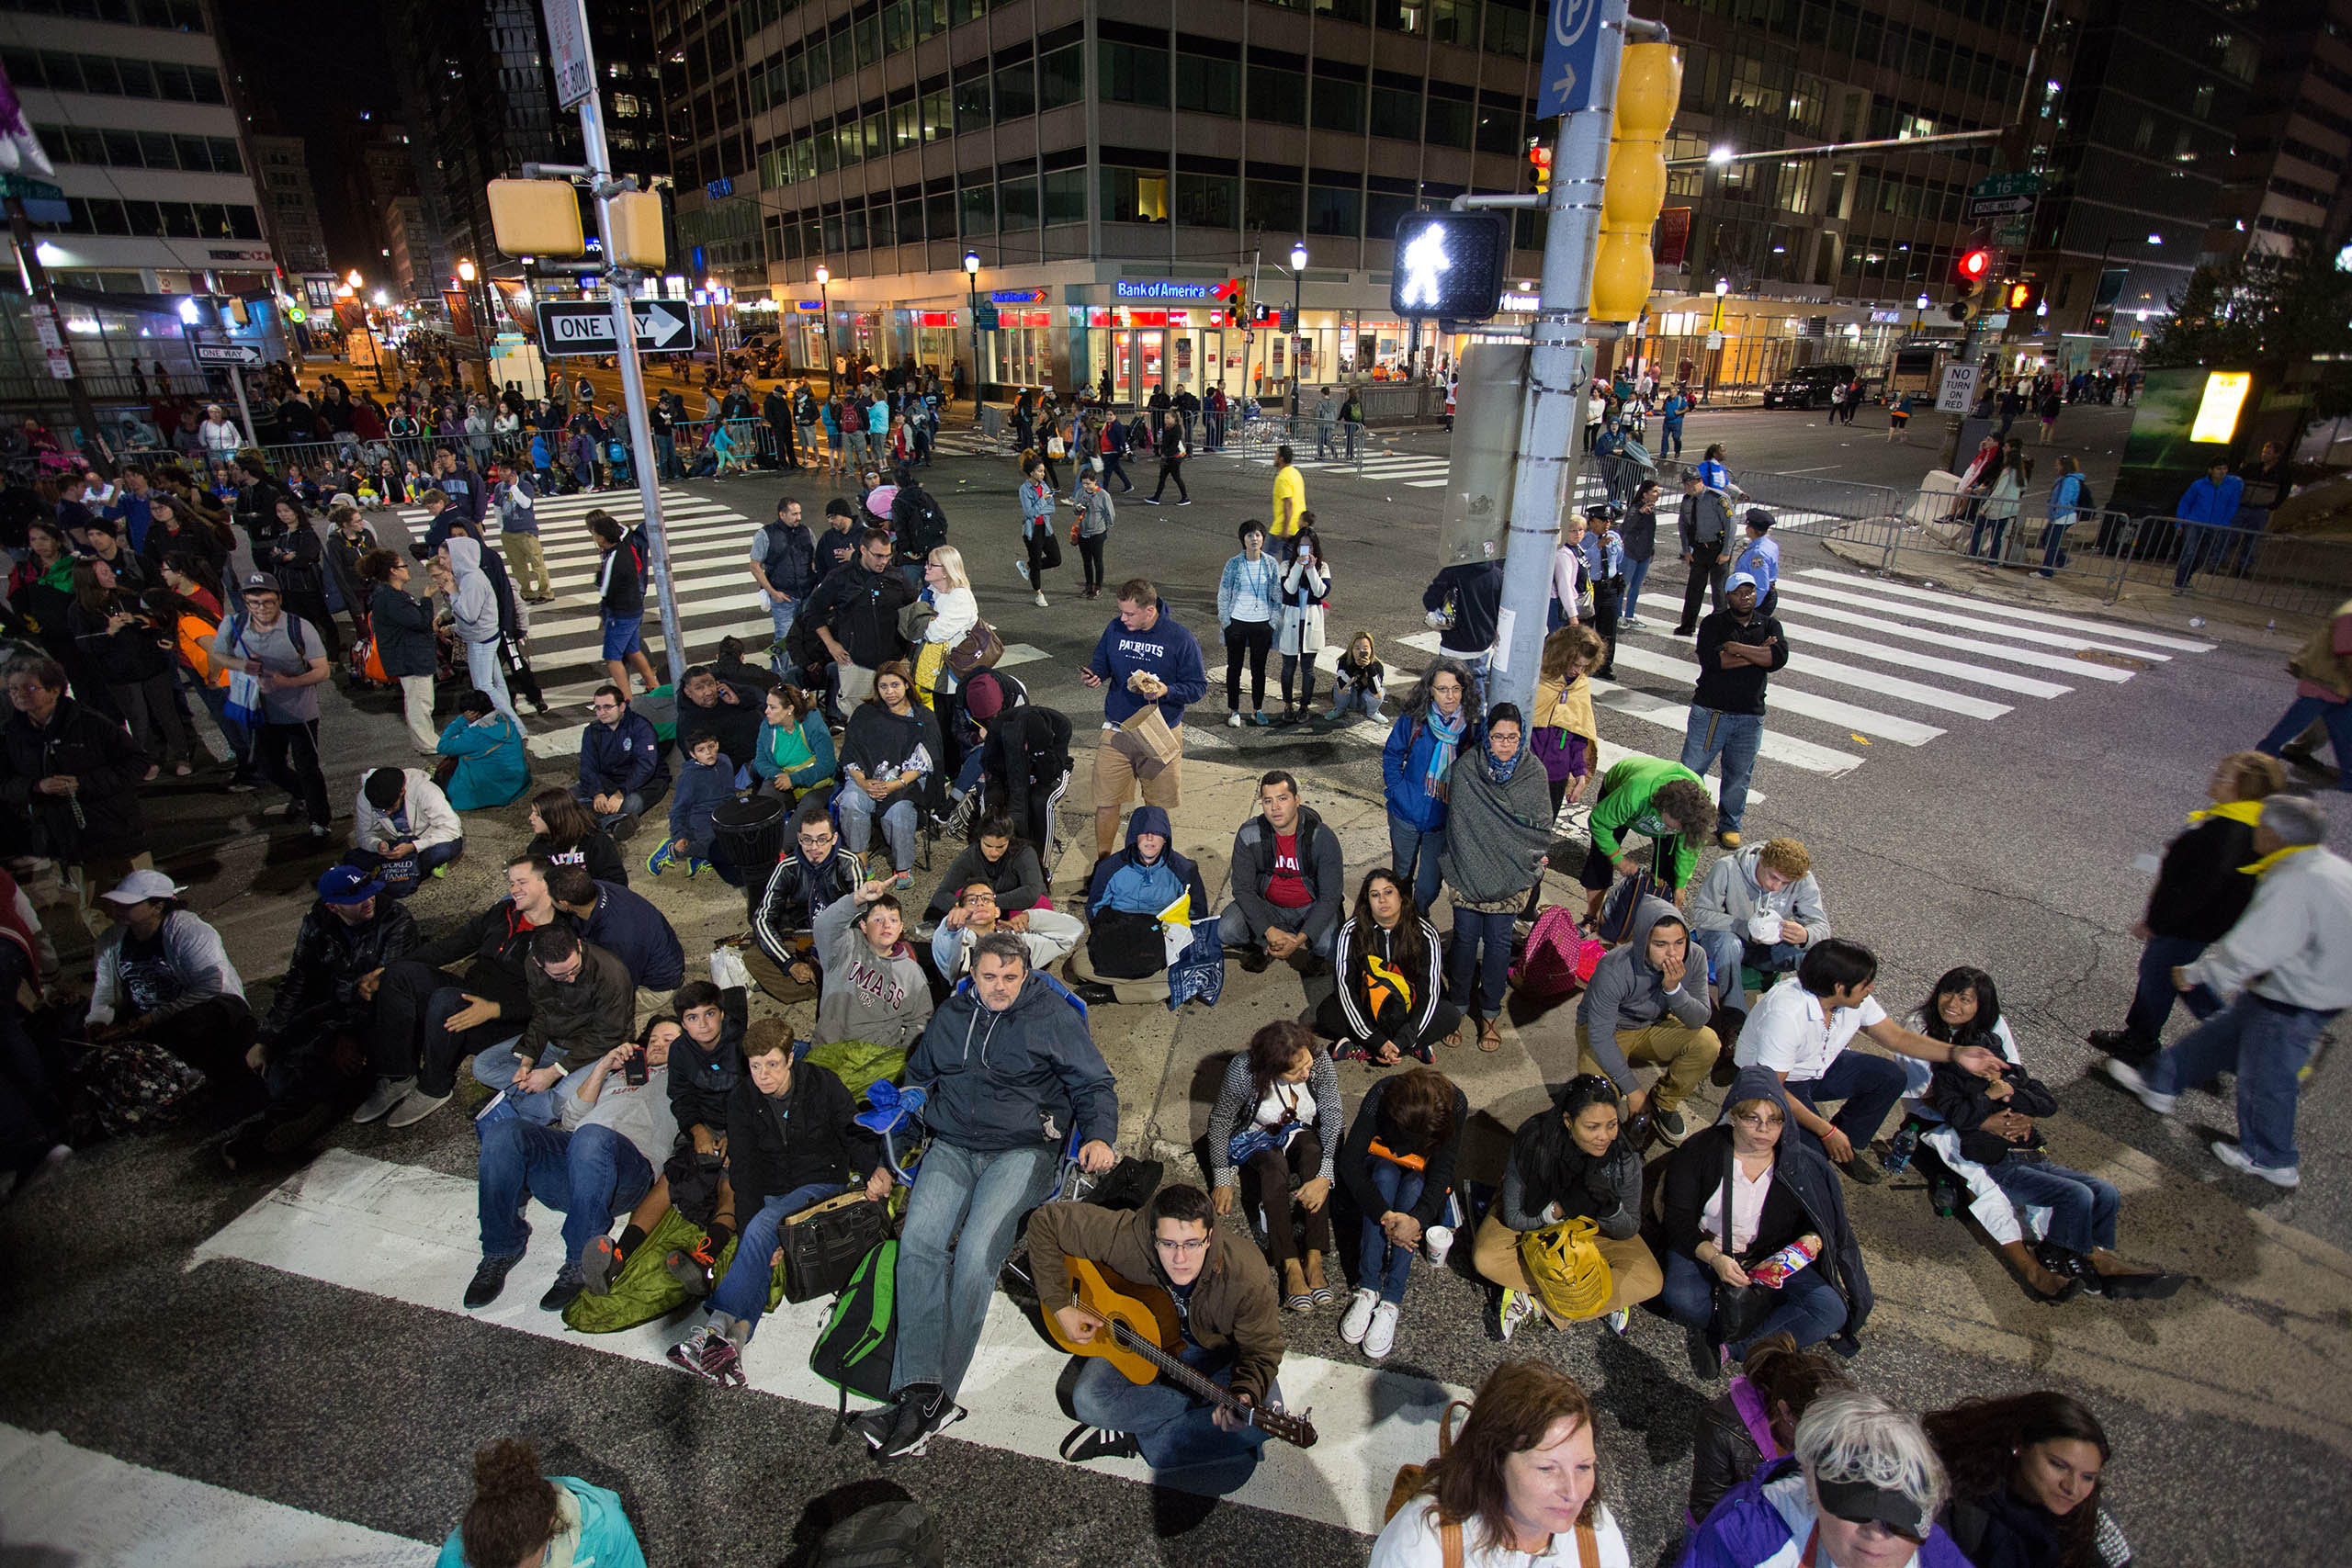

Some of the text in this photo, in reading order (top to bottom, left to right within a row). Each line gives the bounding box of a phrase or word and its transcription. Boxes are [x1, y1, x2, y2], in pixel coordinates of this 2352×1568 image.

[570, 60, 589, 94] BOX
[1117, 280, 1205, 299] Bank of America
[560, 317, 604, 339] ONE
[203, 349, 221, 357] ONE
[1951, 368, 1971, 380] NO
[1946, 380, 1972, 389] TURN
[1949, 390, 1963, 399] ON
[1944, 400, 1963, 409] RED
[1118, 639, 1164, 658] PATRIOTS
[848, 961, 905, 1011] UMASS
